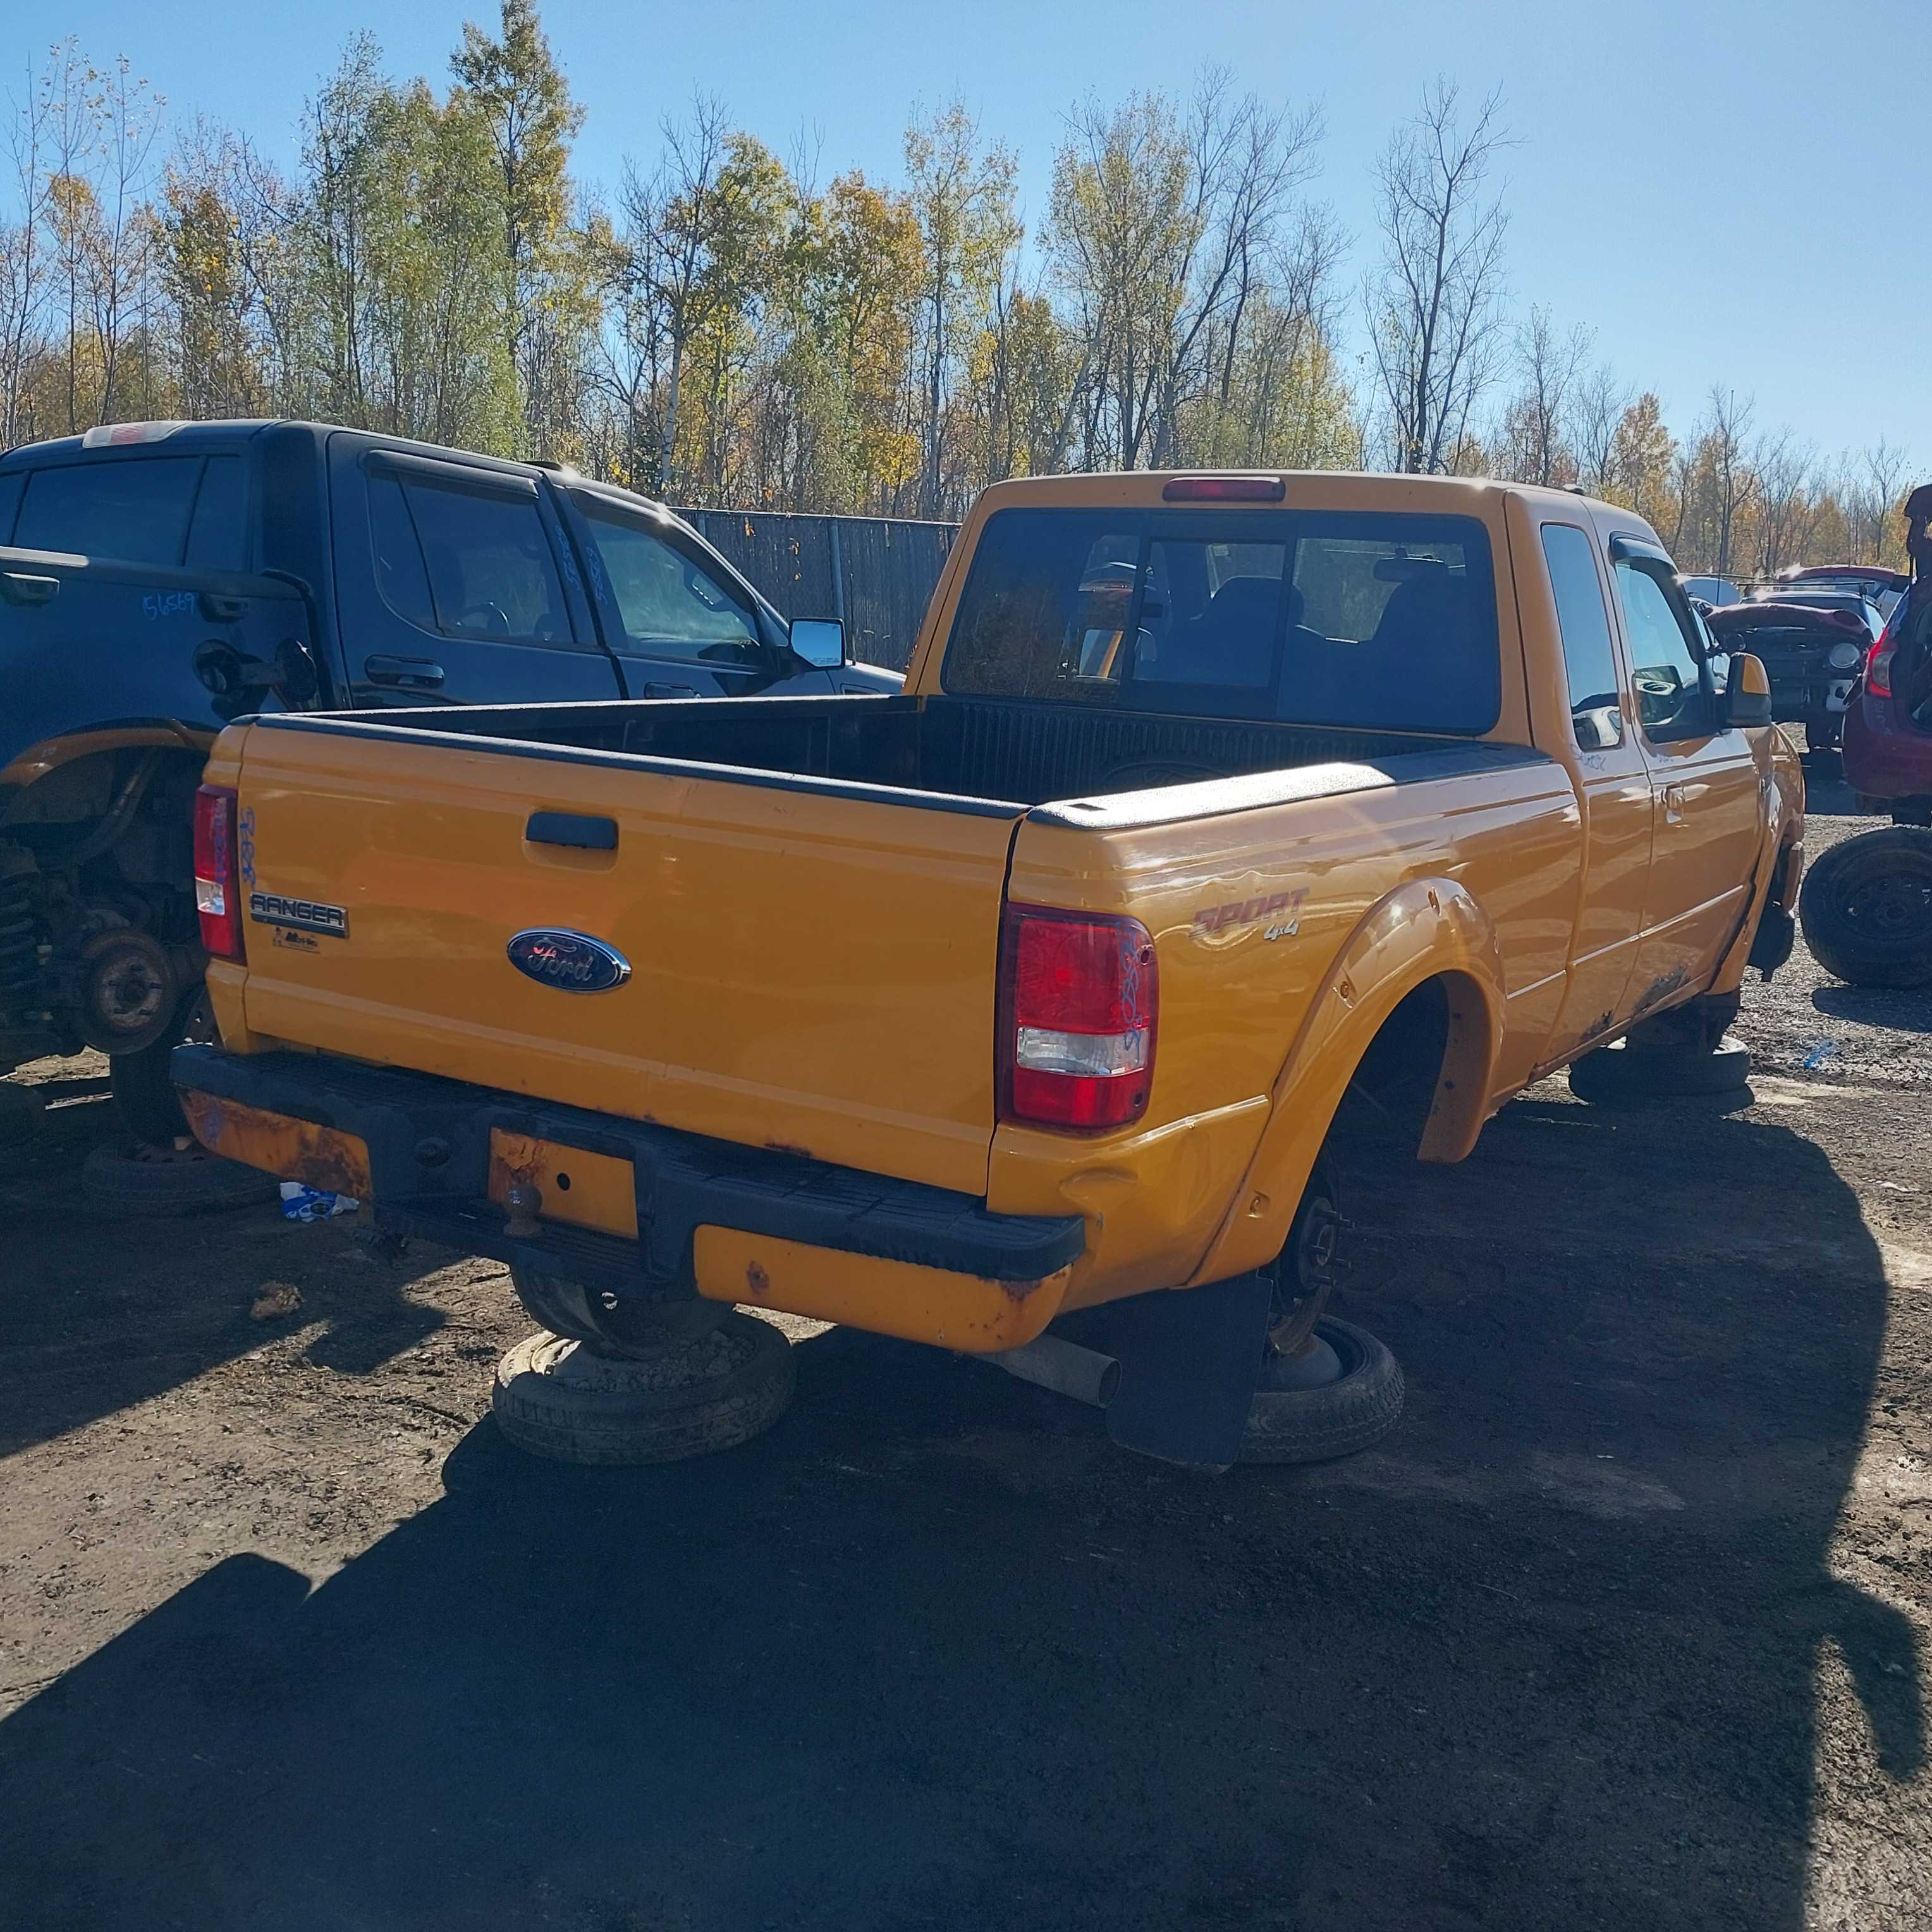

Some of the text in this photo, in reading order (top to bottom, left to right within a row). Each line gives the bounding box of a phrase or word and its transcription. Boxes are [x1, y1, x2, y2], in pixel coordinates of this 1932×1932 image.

[143, 592, 194, 621] 56569
[251, 894, 345, 927] RANGER
[1189, 886, 1310, 938] SPORT
[1263, 919, 1300, 941] 4x4
[527, 938, 593, 982] Ford
